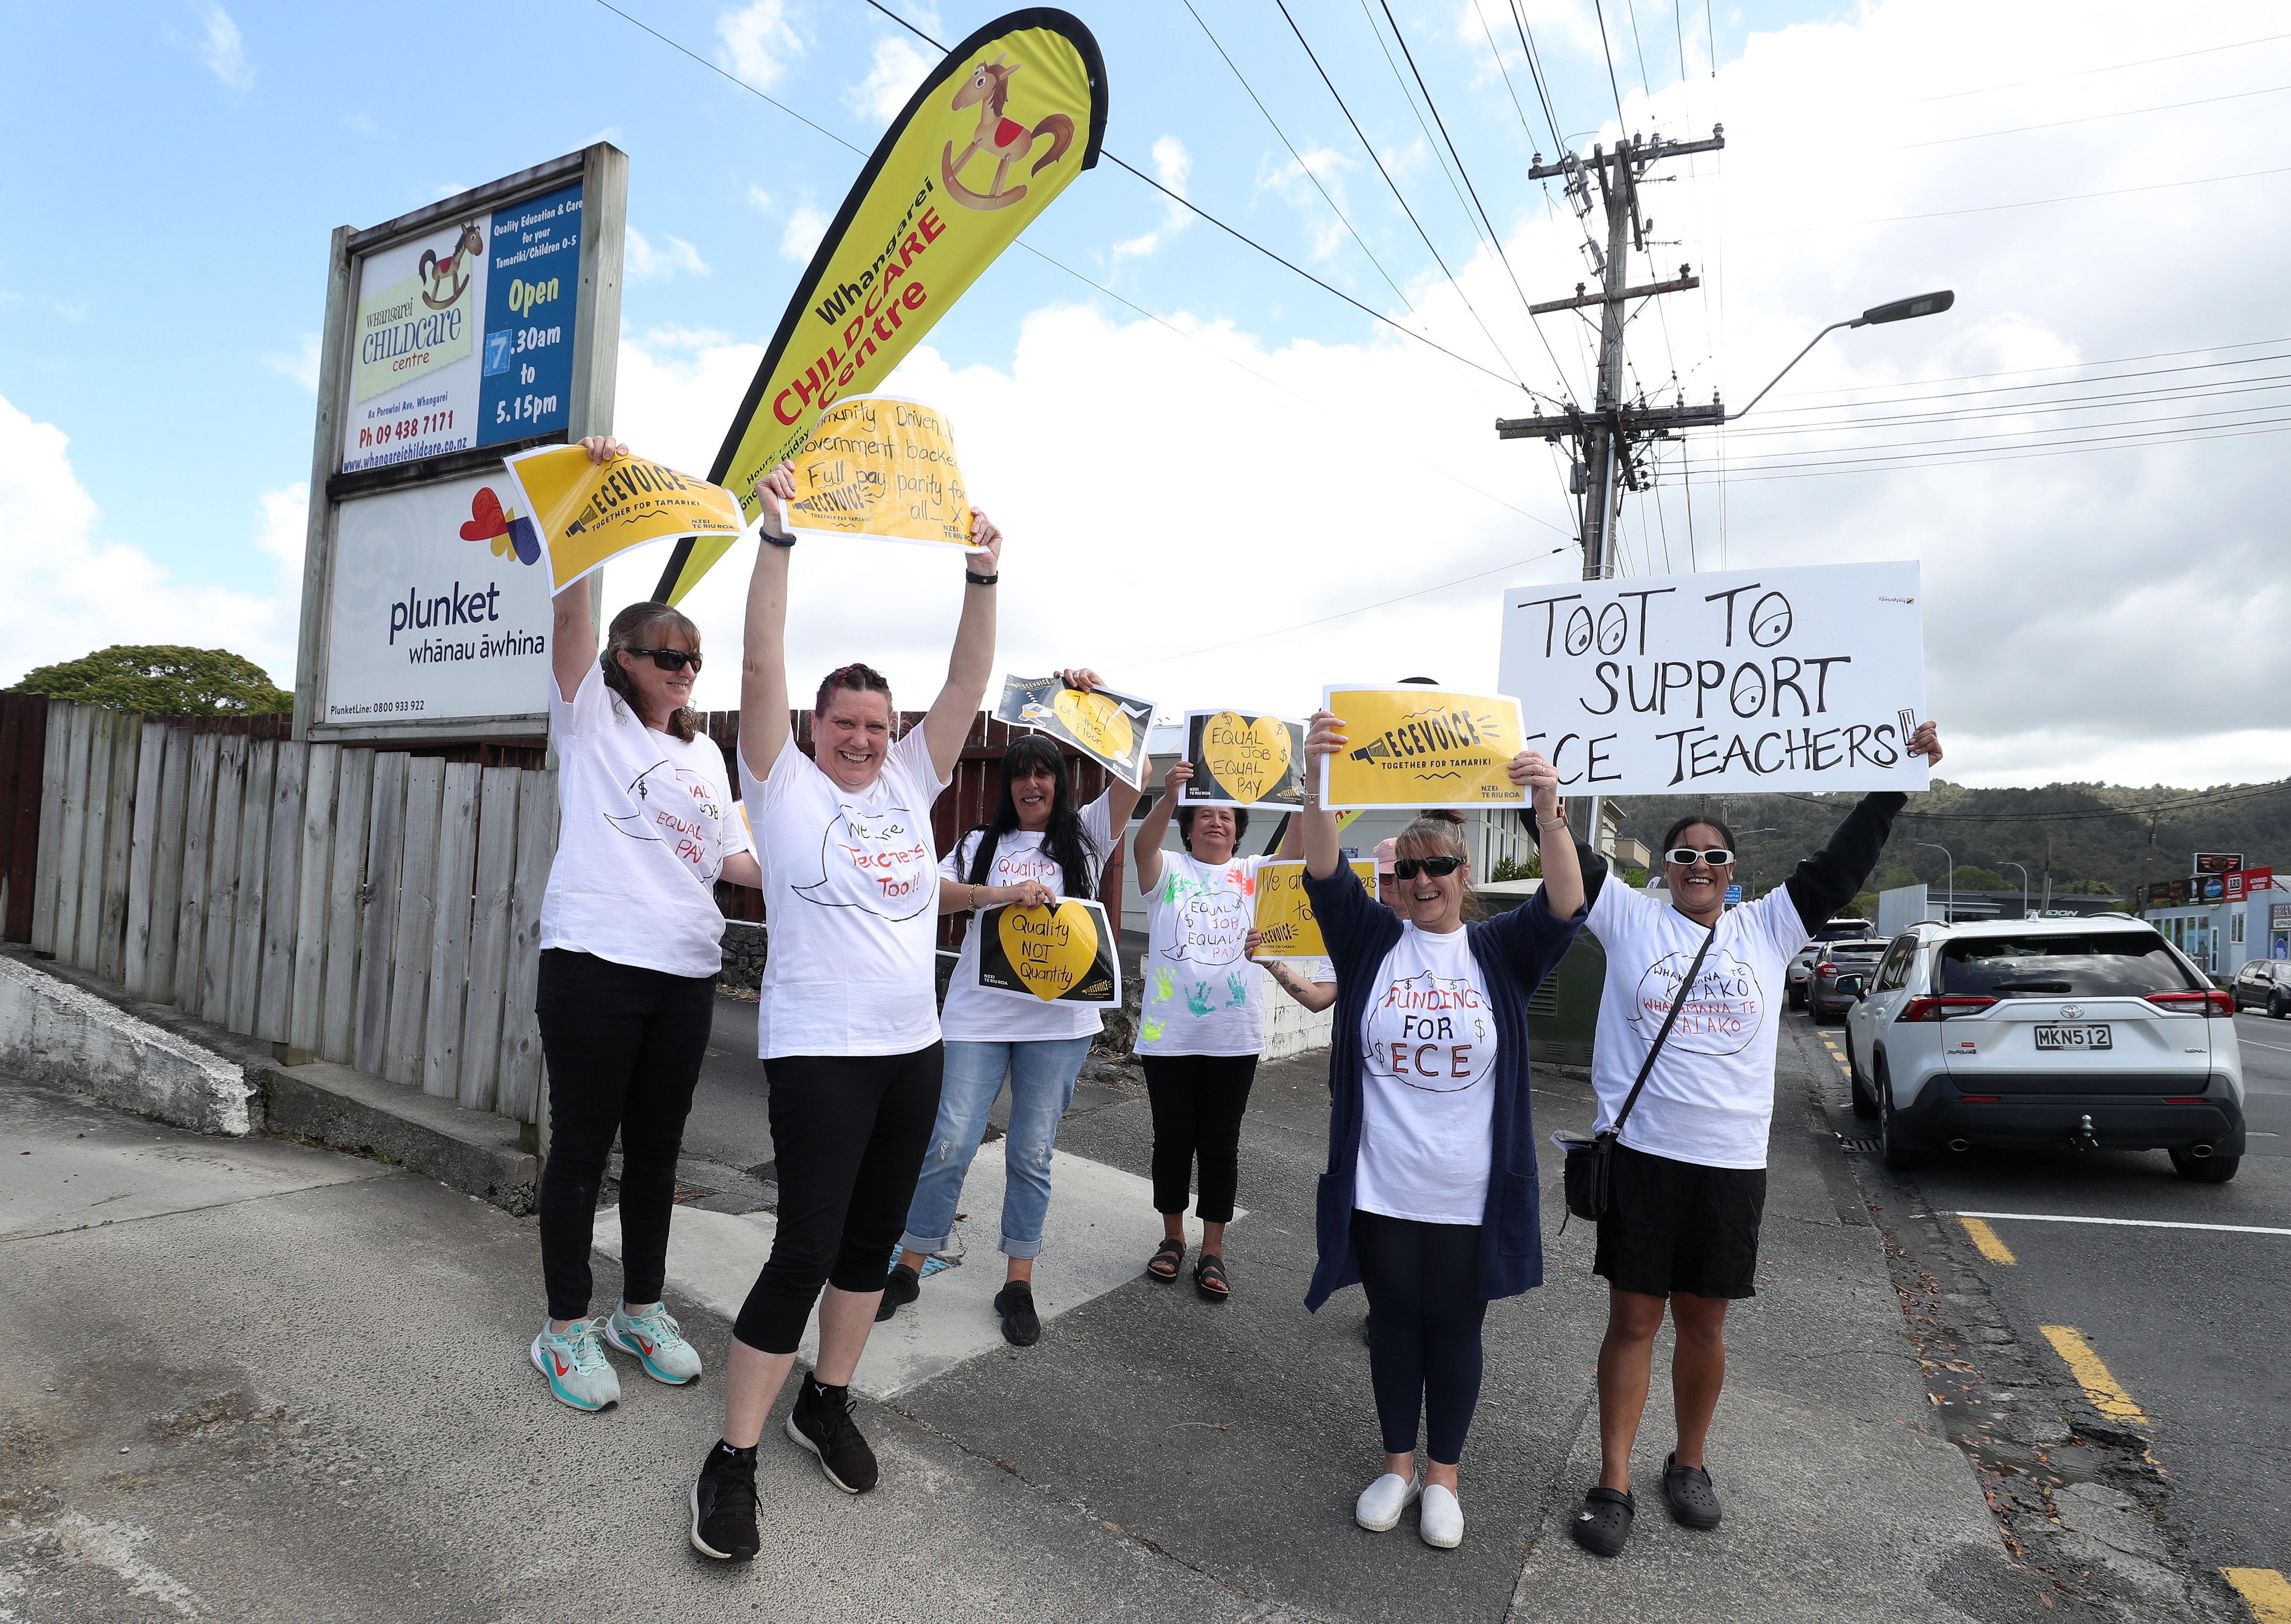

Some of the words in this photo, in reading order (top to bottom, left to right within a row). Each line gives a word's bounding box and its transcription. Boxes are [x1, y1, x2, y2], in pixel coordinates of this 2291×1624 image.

[494, 221, 519, 237] Quality
[521, 209, 555, 227] Education
[558, 204, 564, 215] &
[566, 200, 583, 212] Care
[522, 232, 533, 244] for
[535, 228, 550, 243] your
[496, 242, 560, 269] Tamariki/Children
[562, 235, 576, 249] 0-5
[815, 176, 934, 326] Whangarei
[508, 277, 559, 318] Open
[773, 206, 947, 426] CHILDCARE
[490, 326, 561, 370] 7.30am
[817, 281, 927, 410] Centre
[393, 352, 430, 372] centre
[520, 363, 535, 385] to
[368, 410, 375, 419] 8a
[377, 403, 400, 417] Porowini
[402, 401, 414, 411] Ave,
[417, 391, 448, 407] Whangarei
[496, 394, 557, 424] 5.15pm
[359, 427, 372, 448] Ph
[377, 424, 391, 445] 09
[395, 418, 418, 440] 438
[424, 410, 453, 434] 7171
[344, 437, 467, 472] www.whangareichildcare.co.nz
[781, 429, 809, 462] Friday
[800, 435, 894, 460] overnment
[746, 451, 775, 485] Hours:
[591, 464, 687, 514] ECEVOICE
[808, 461, 844, 490] Full
[856, 470, 886, 498] pay
[898, 471, 942, 506] parity
[812, 483, 864, 513] ECEVOICE
[591, 506, 630, 532] TOGETHER
[634, 501, 651, 511] FOR
[389, 581, 500, 645] plunket
[1518, 587, 1676, 658] TOOT
[1704, 582, 1793, 648] TO
[409, 638, 475, 665] whānau
[480, 630, 545, 659] āwhina
[1579, 656, 1852, 719] SUPPORT
[331, 704, 371, 714] PlunketLine:
[374, 702, 393, 713] 0800
[395, 701, 408, 712] 933
[410, 700, 424, 711] 922
[1060, 705, 1075, 718] on
[1082, 718, 1102, 735] the
[1212, 728, 1264, 745] EQUAL
[1385, 711, 1481, 757] ECEVOICE
[1240, 746, 1271, 760] JOB
[1382, 761, 1427, 770] TOGETHER
[1430, 760, 1447, 768] FOR
[1450, 758, 1491, 767] TAMARIKI
[1526, 732, 1622, 785] CE
[1213, 759, 1264, 776] EQUAL
[1237, 777, 1262, 798] PAY
[656, 812, 703, 840] EQUAL
[675, 839, 705, 864] PAY
[877, 871, 920, 897] Too!!
[1262, 868, 1280, 894] We
[1289, 873, 1303, 890] ar
[1192, 901, 1231, 915] EQUAL
[1292, 900, 1314, 921] to
[1012, 914, 1069, 946] Quality
[1212, 917, 1238, 930] JOB
[1261, 923, 1292, 943] ECEVOICE
[1022, 940, 1054, 961] NOT
[1189, 932, 1234, 946] EQUAL
[1020, 962, 1073, 990] Quantity
[1731, 967, 1745, 976] TE
[1384, 987, 1478, 1010] FUNDING
[1665, 979, 1748, 1002] KIAKO
[1740, 1001, 1757, 1014] TE
[1403, 1015, 1453, 1040] FOR
[2038, 1030, 2108, 1045] MKN512
[1391, 1043, 1472, 1078] ECE
